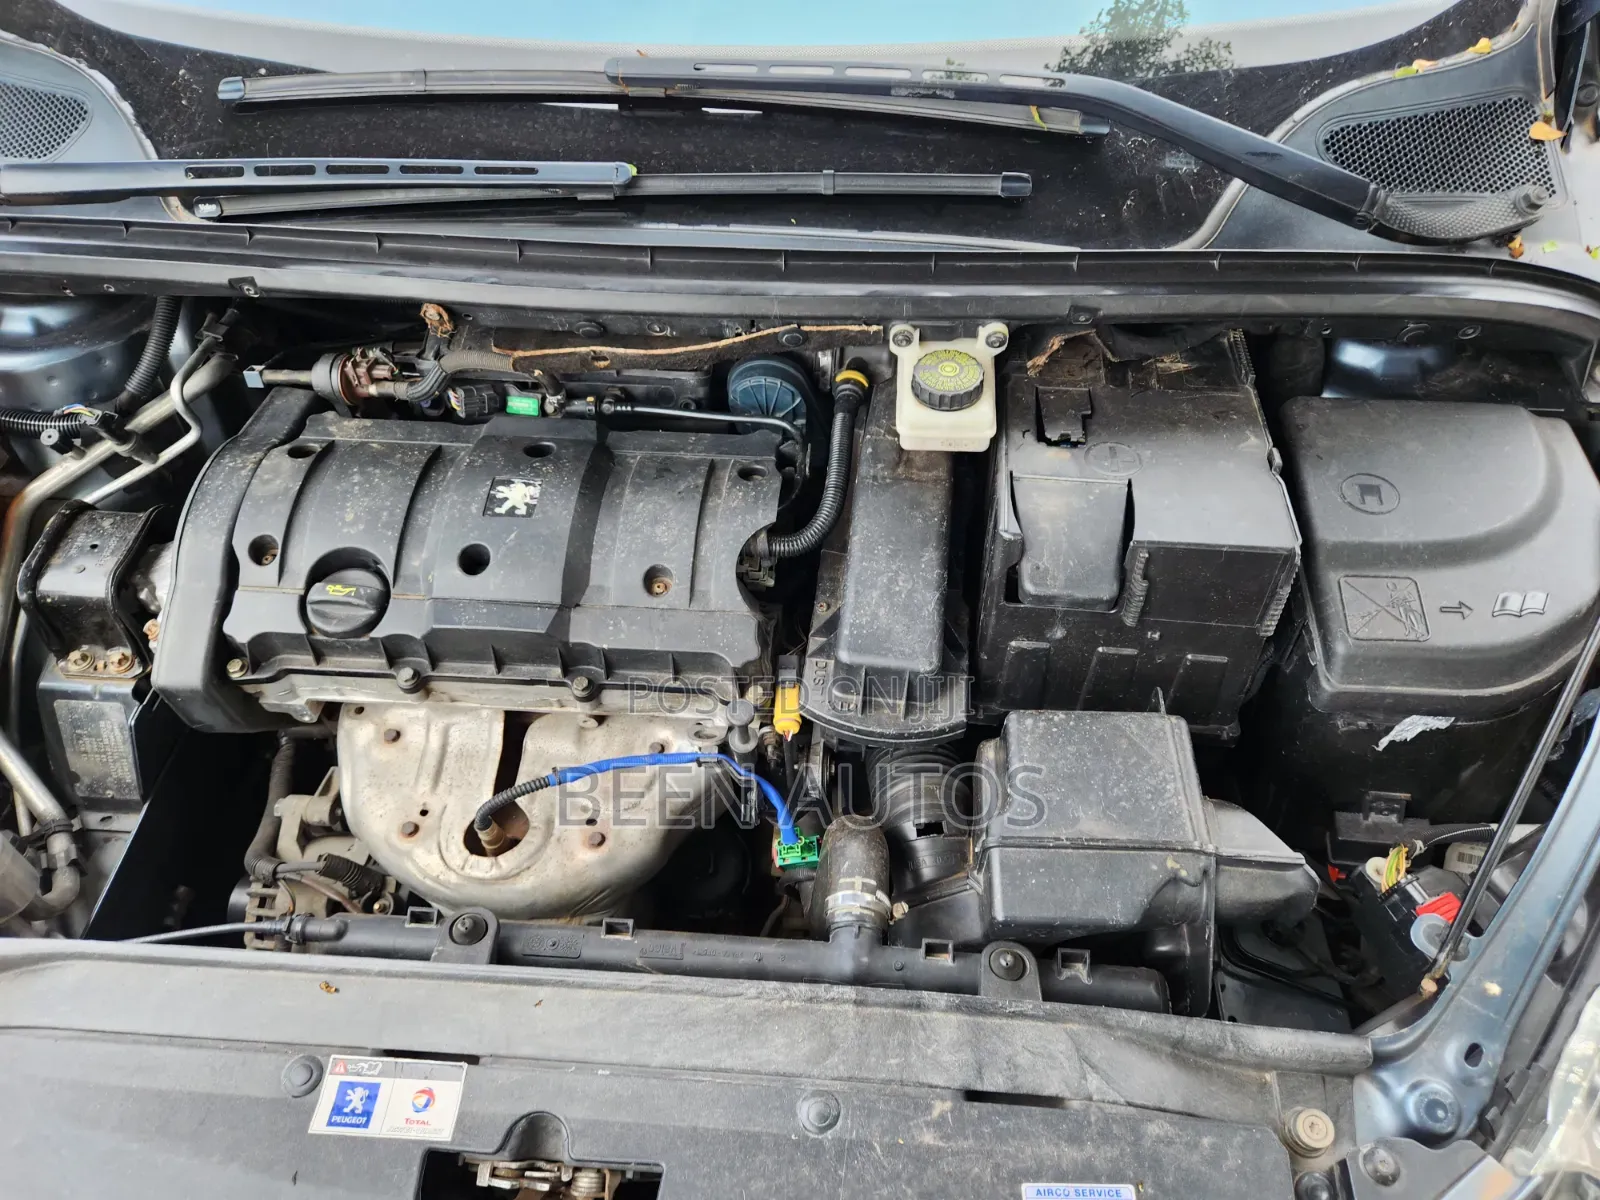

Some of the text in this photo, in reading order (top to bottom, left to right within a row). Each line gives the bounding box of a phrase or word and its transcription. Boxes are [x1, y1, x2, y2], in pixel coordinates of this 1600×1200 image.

[331, 1115, 368, 1125] PEUGEOT
[404, 1117, 432, 1126] TOTAL
[1035, 1188, 1122, 1198] AIRCO SERVICE
